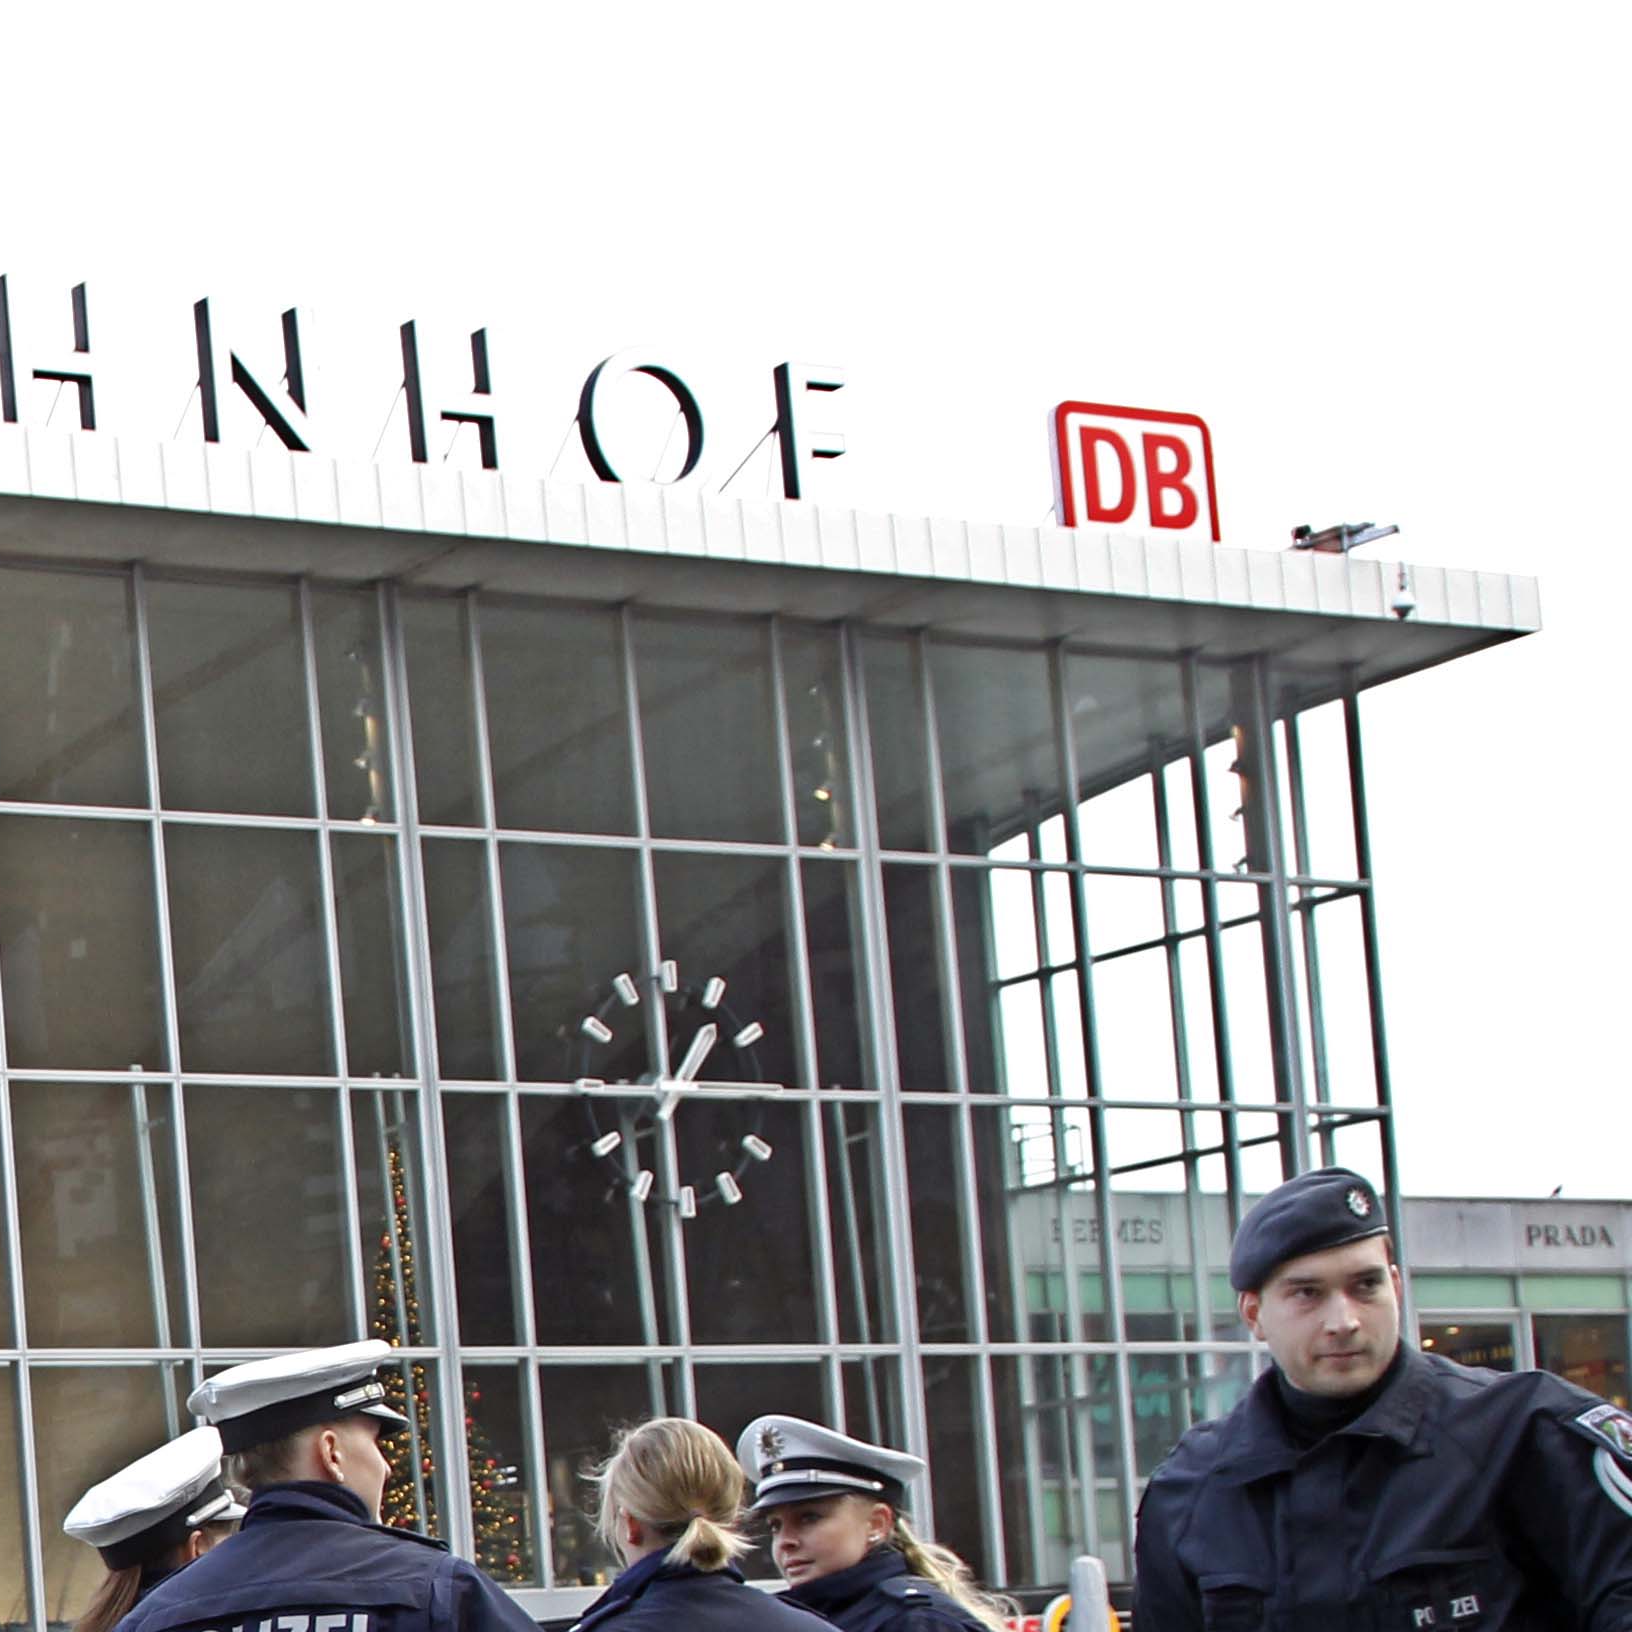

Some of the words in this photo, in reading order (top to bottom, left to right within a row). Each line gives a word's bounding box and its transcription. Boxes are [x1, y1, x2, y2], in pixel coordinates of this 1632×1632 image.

[1078, 425, 1199, 530] DB
[1526, 1223, 1615, 1248] PRADA
[1413, 1594, 1480, 1627] POZEI
